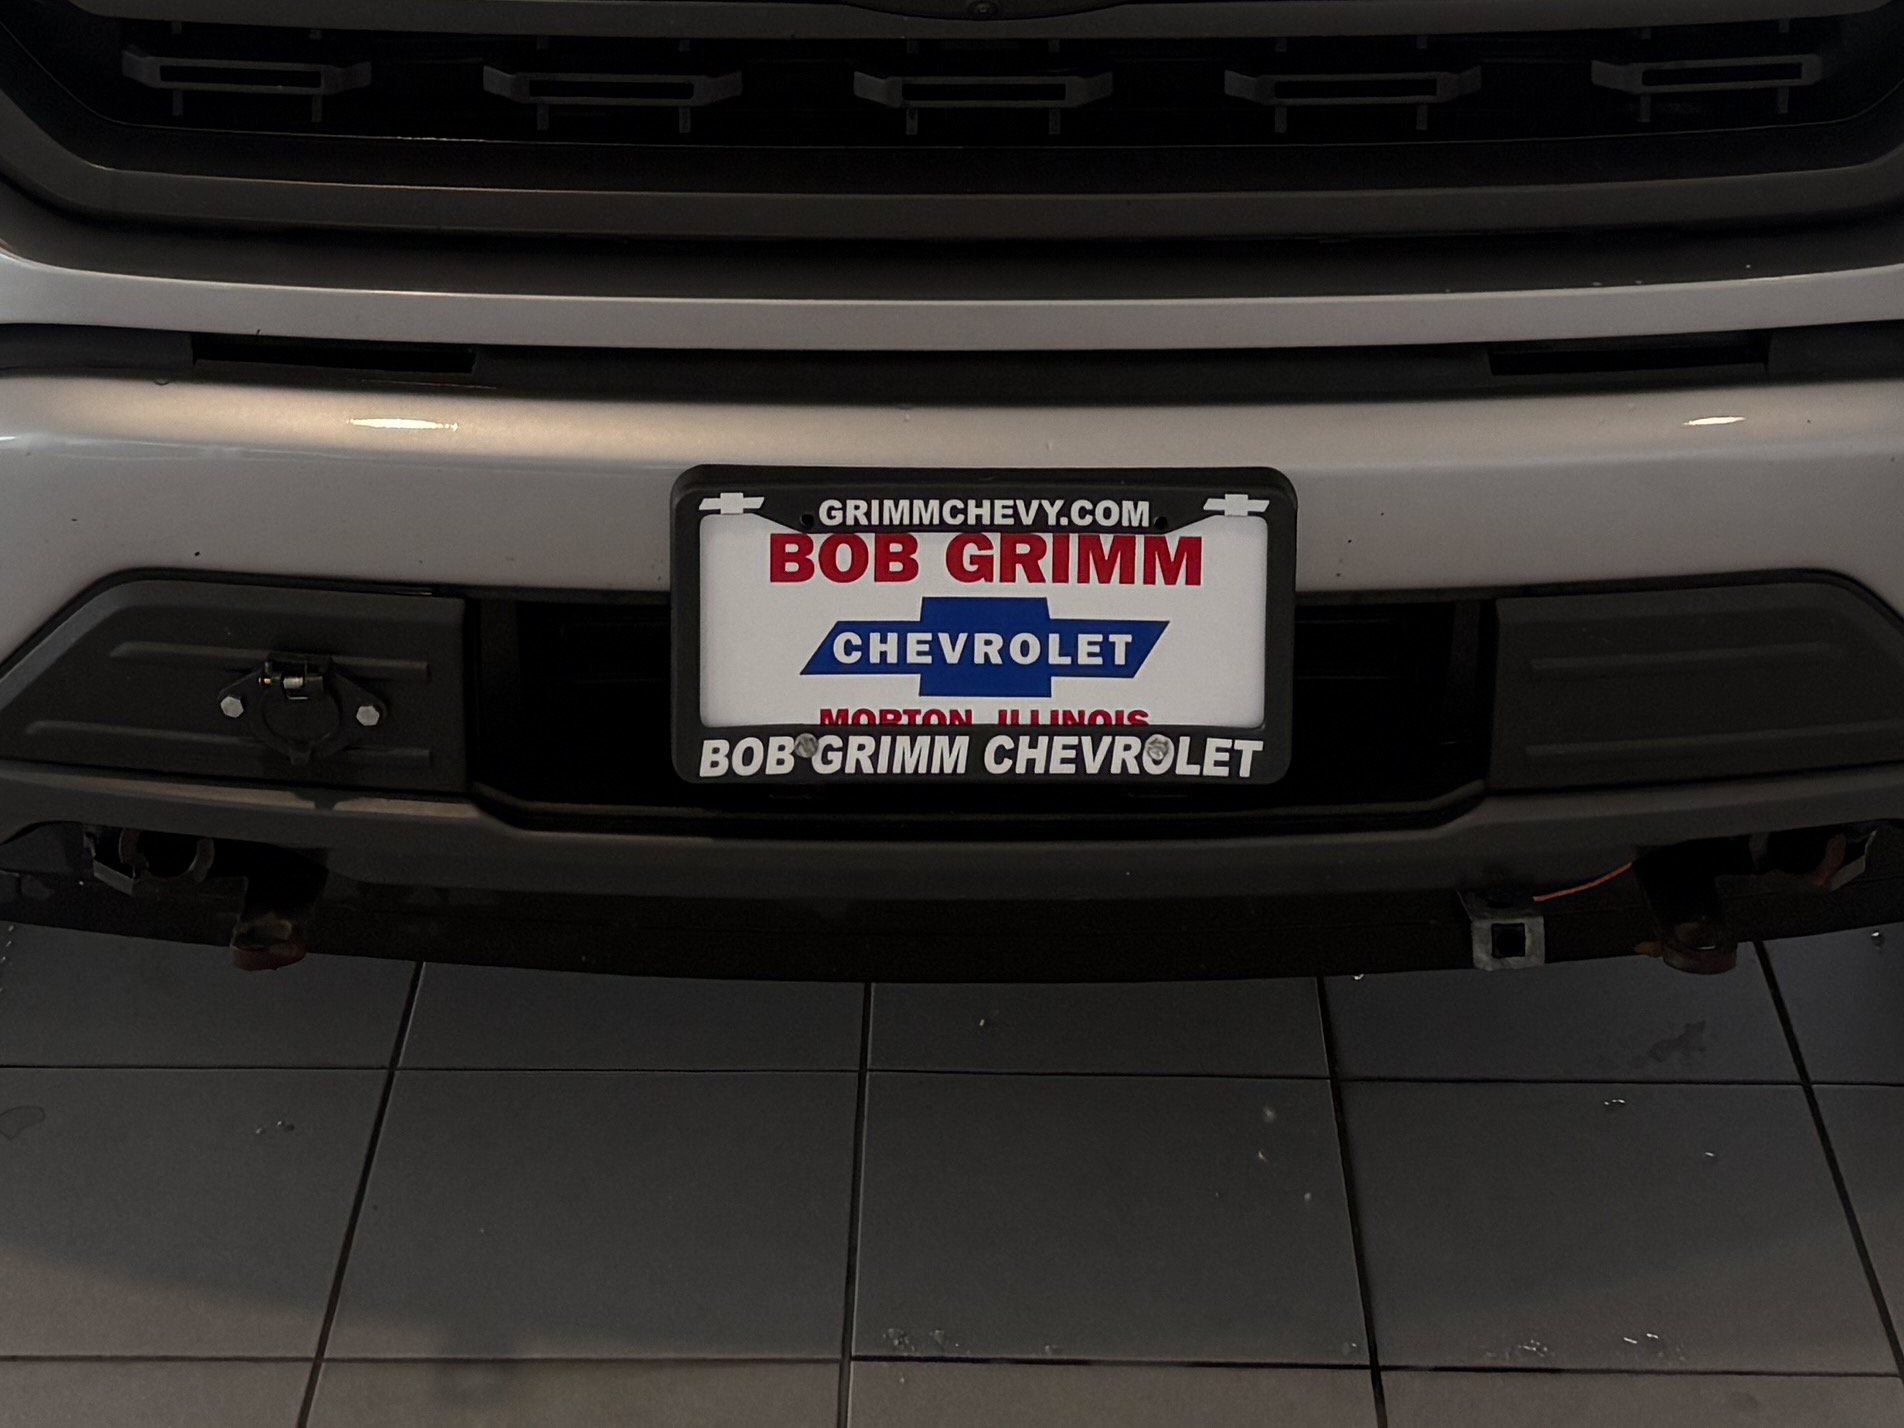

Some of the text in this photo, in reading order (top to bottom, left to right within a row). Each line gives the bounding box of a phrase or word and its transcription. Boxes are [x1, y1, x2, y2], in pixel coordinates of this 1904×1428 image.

[819, 499, 1150, 527] GRIMMCHEVY.COM
[770, 533, 1203, 586] BOB GRIMM
[832, 629, 1133, 667] CHEVROLET
[699, 735, 1264, 777] BOB GRIMM CHEVROLET
